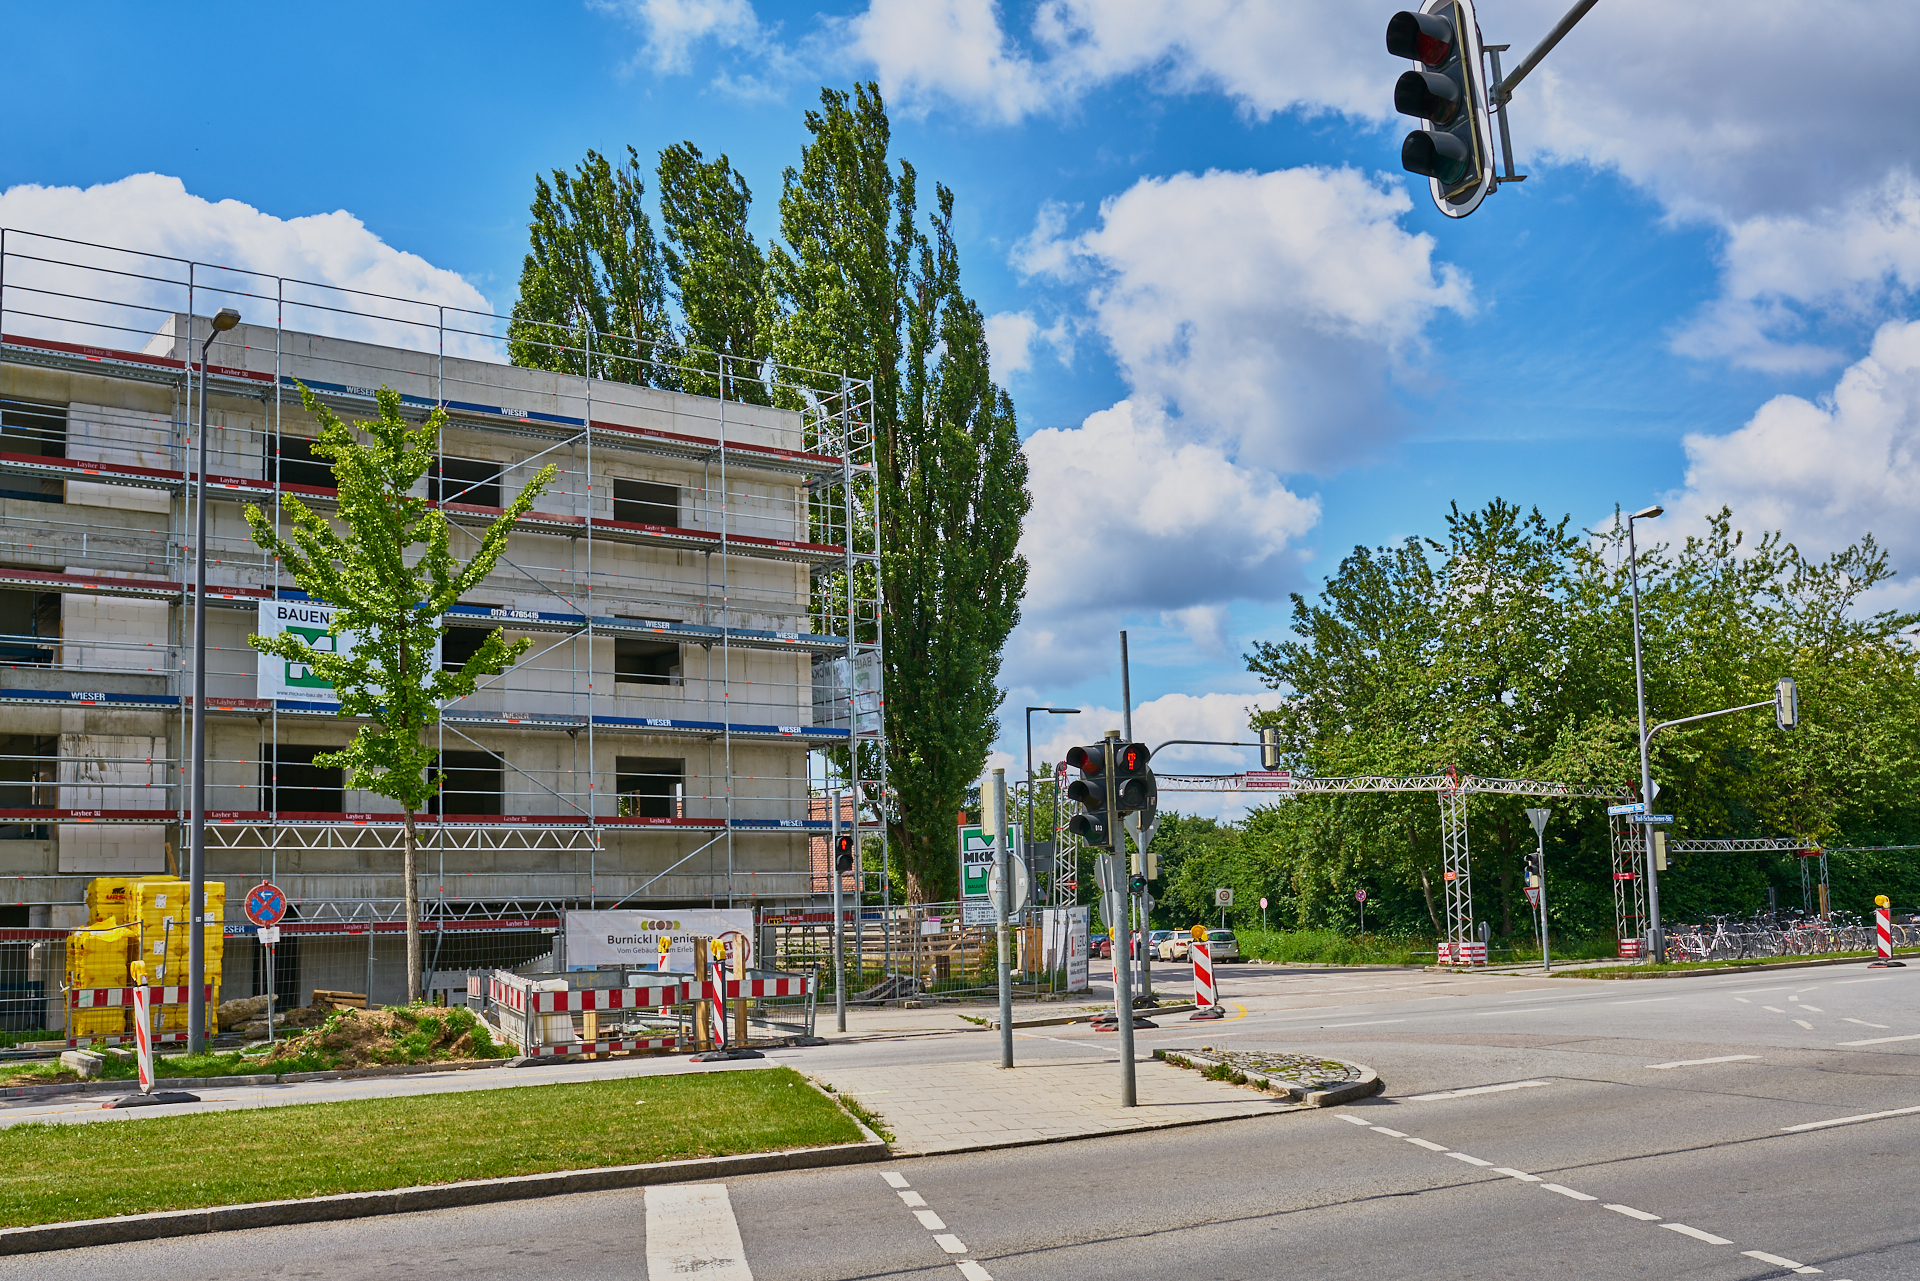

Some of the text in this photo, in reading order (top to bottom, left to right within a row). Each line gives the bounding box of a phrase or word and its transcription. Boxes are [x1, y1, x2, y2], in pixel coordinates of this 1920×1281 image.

[221, 367, 241, 376] Layher
[346, 385, 375, 397] WIESER
[501, 407, 528, 418] WIESER
[77, 461, 98, 470] Layher
[220, 476, 239, 485] Layher
[277, 606, 330, 624] BAUEN
[645, 620, 670, 629] WIESER
[775, 631, 799, 640] WIESER
[71, 691, 106, 701] WIESER
[646, 718, 672, 727] WIESER
[777, 725, 802, 734] WIESER
[607, 934, 652, 945] Burnickl
